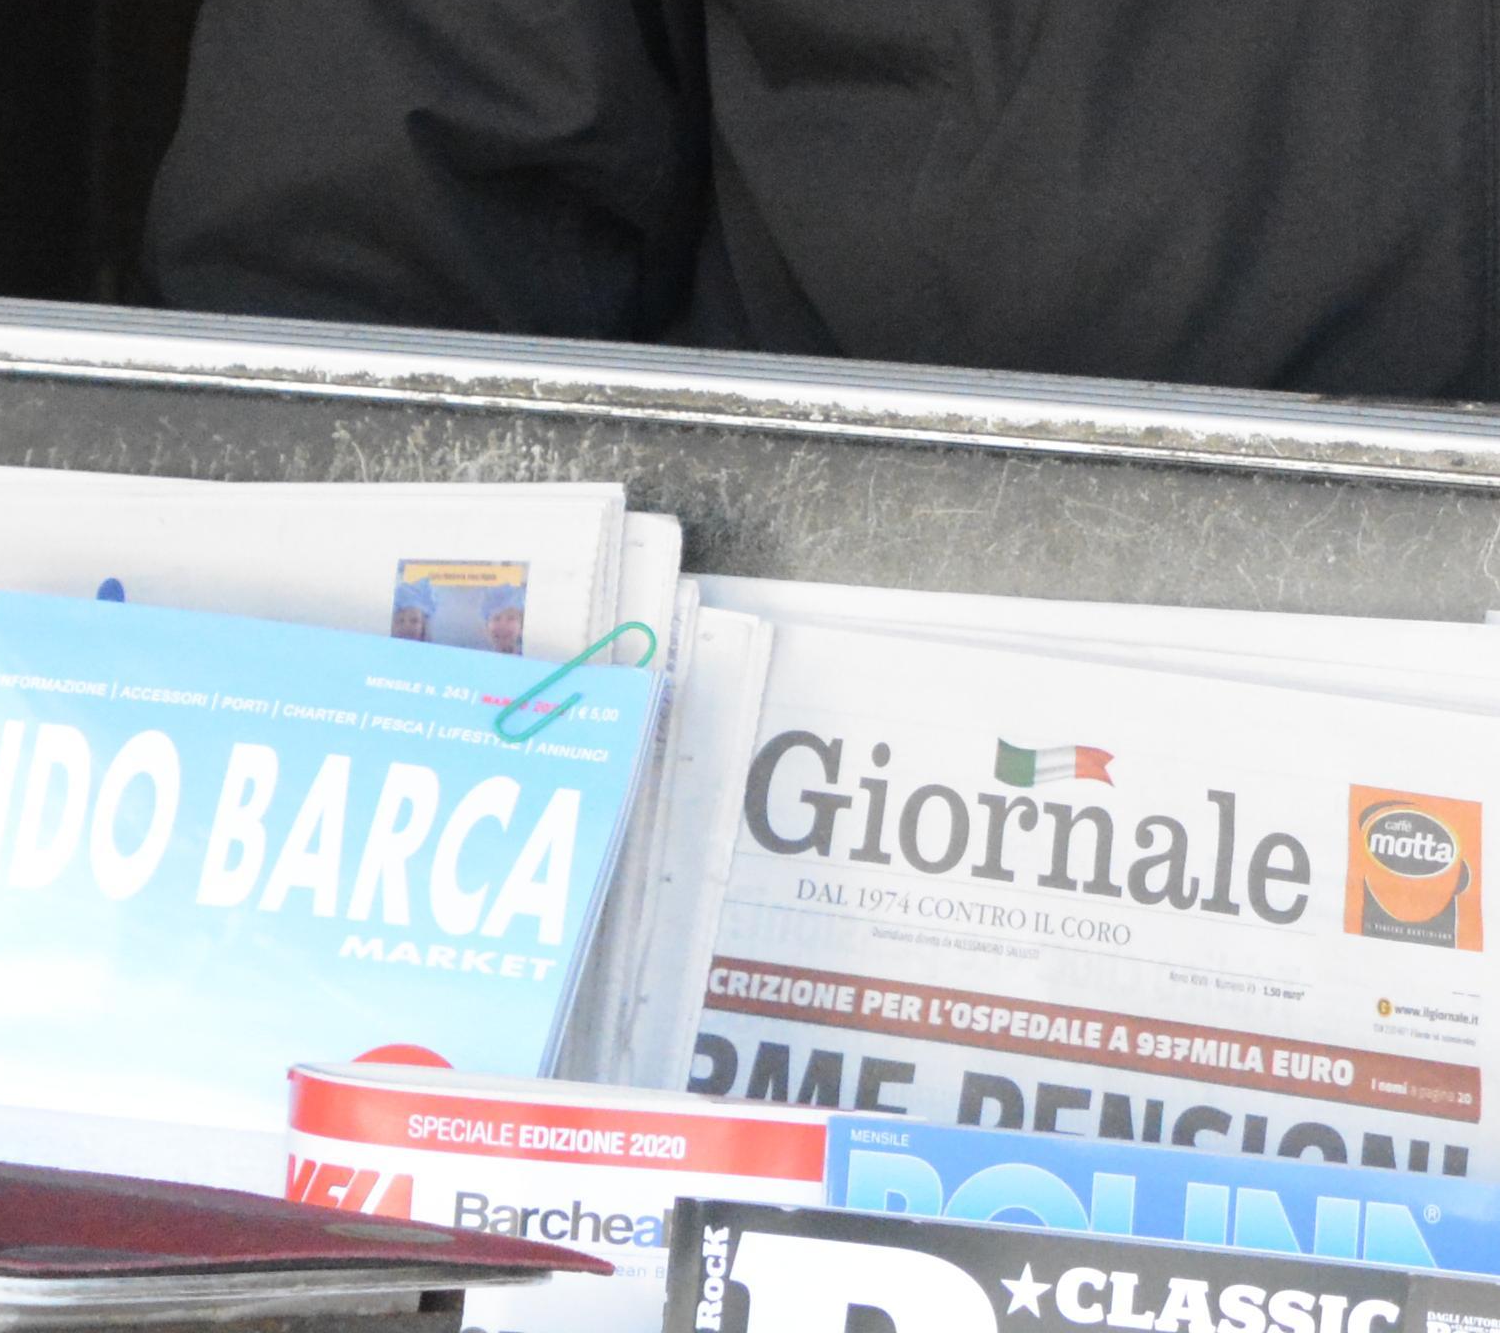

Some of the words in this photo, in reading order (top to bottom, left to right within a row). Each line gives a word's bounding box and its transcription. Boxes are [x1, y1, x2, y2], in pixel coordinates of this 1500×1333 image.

[119, 684, 209, 708] ACCESSORI
[220, 695, 269, 715] PORTI
[282, 702, 357, 727] CHARTER
[370, 714, 424, 735] PESCA
[533, 740, 610, 763] ANNUNCI
[196, 742, 582, 946] BARCA
[743, 728, 1311, 926] Giornale
[1369, 831, 1456, 865] motta
[795, 877, 848, 909] DAL
[855, 885, 910, 915] 1974
[916, 895, 1027, 931] CONTRO
[1032, 908, 1058, 935] IL
[1060, 914, 1133, 947] CORO
[338, 932, 557, 981] MARKET
[860, 987, 922, 1024] PER
[928, 999, 1102, 1050] L'OSPEDALE
[1107, 1023, 1130, 1054] A
[1135, 1027, 1264, 1076] 937MILA
[1271, 1046, 1355, 1087] EURO
[407, 1113, 514, 1147] SPECIALE
[517, 1120, 627, 1157] EDIZIONE
[629, 1132, 687, 1162] 2020
[850, 1128, 911, 1149] MENSILE
